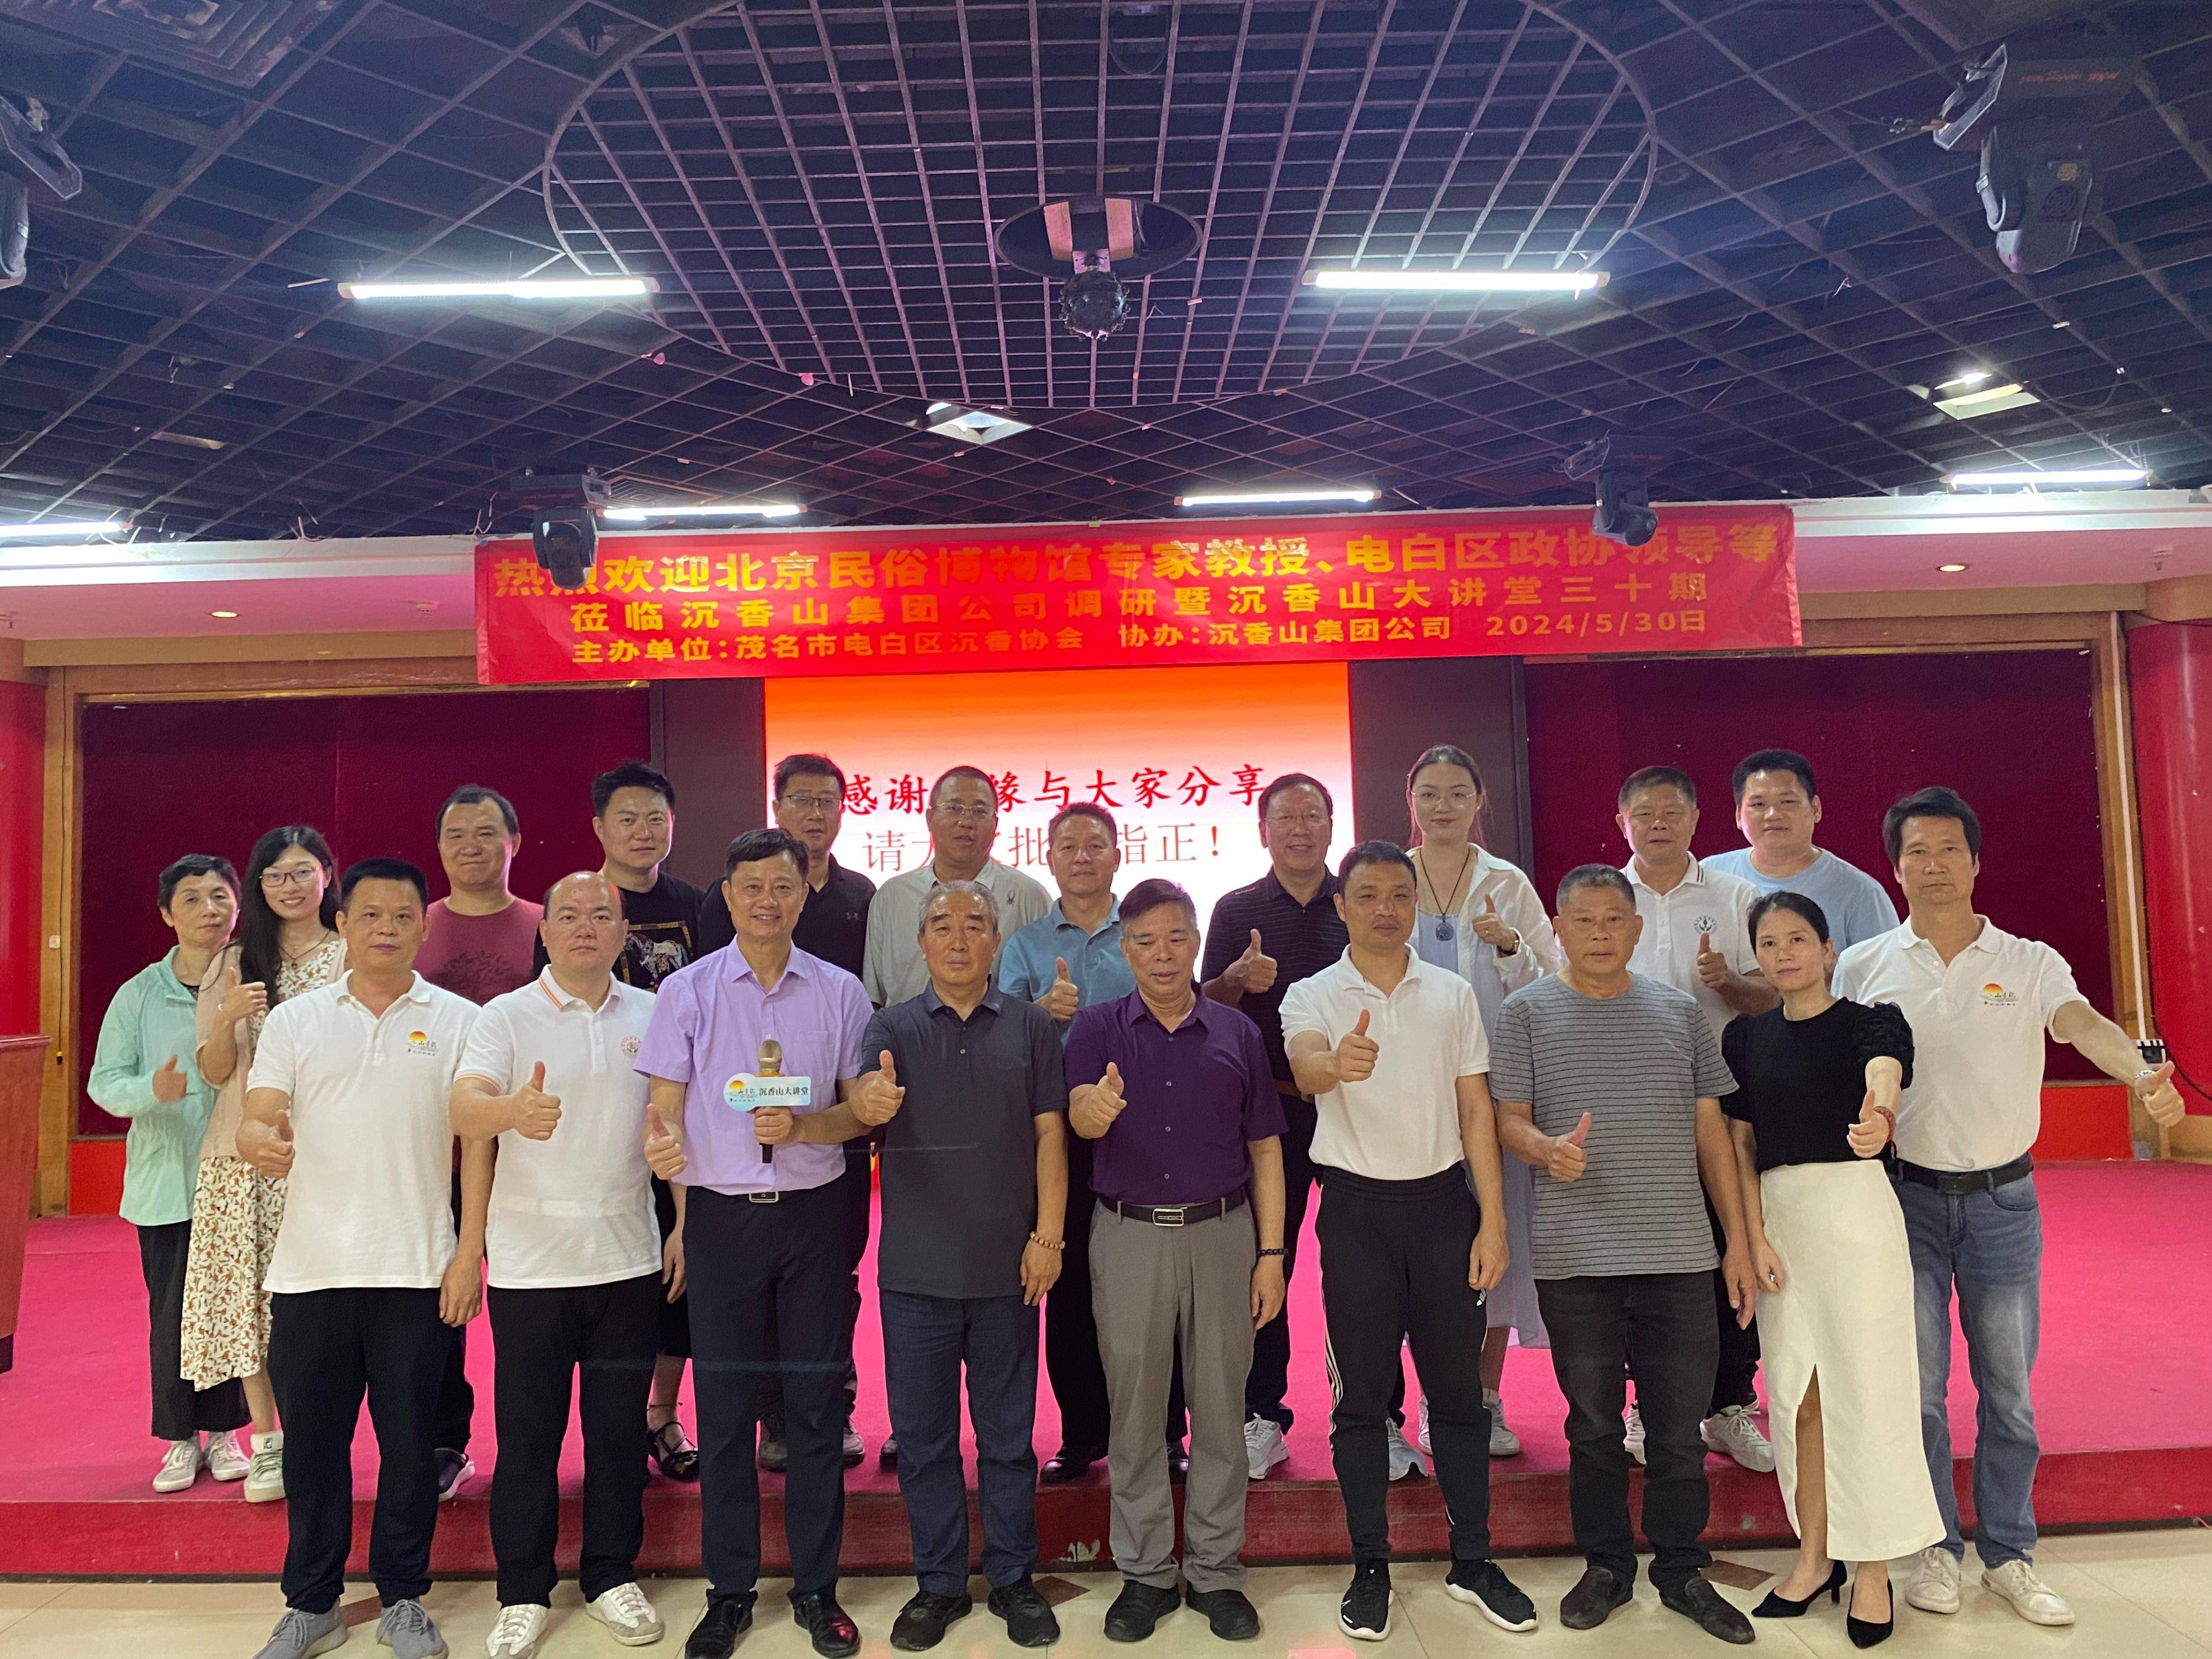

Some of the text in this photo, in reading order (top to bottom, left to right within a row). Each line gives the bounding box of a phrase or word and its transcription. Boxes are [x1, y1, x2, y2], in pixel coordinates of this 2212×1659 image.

[570, 572, 1707, 633] 莅临沉香山集团公司调研暨沉香山大讲堂三十期
[571, 609, 1706, 663] 主办单位:茂名市电白区沉香协会 协办:沉香山集团公司 2024/5/30日
[842, 764, 1267, 815] 感谢缘与大家分享
[759, 1086, 809, 1096] 沉香山大讲堂
